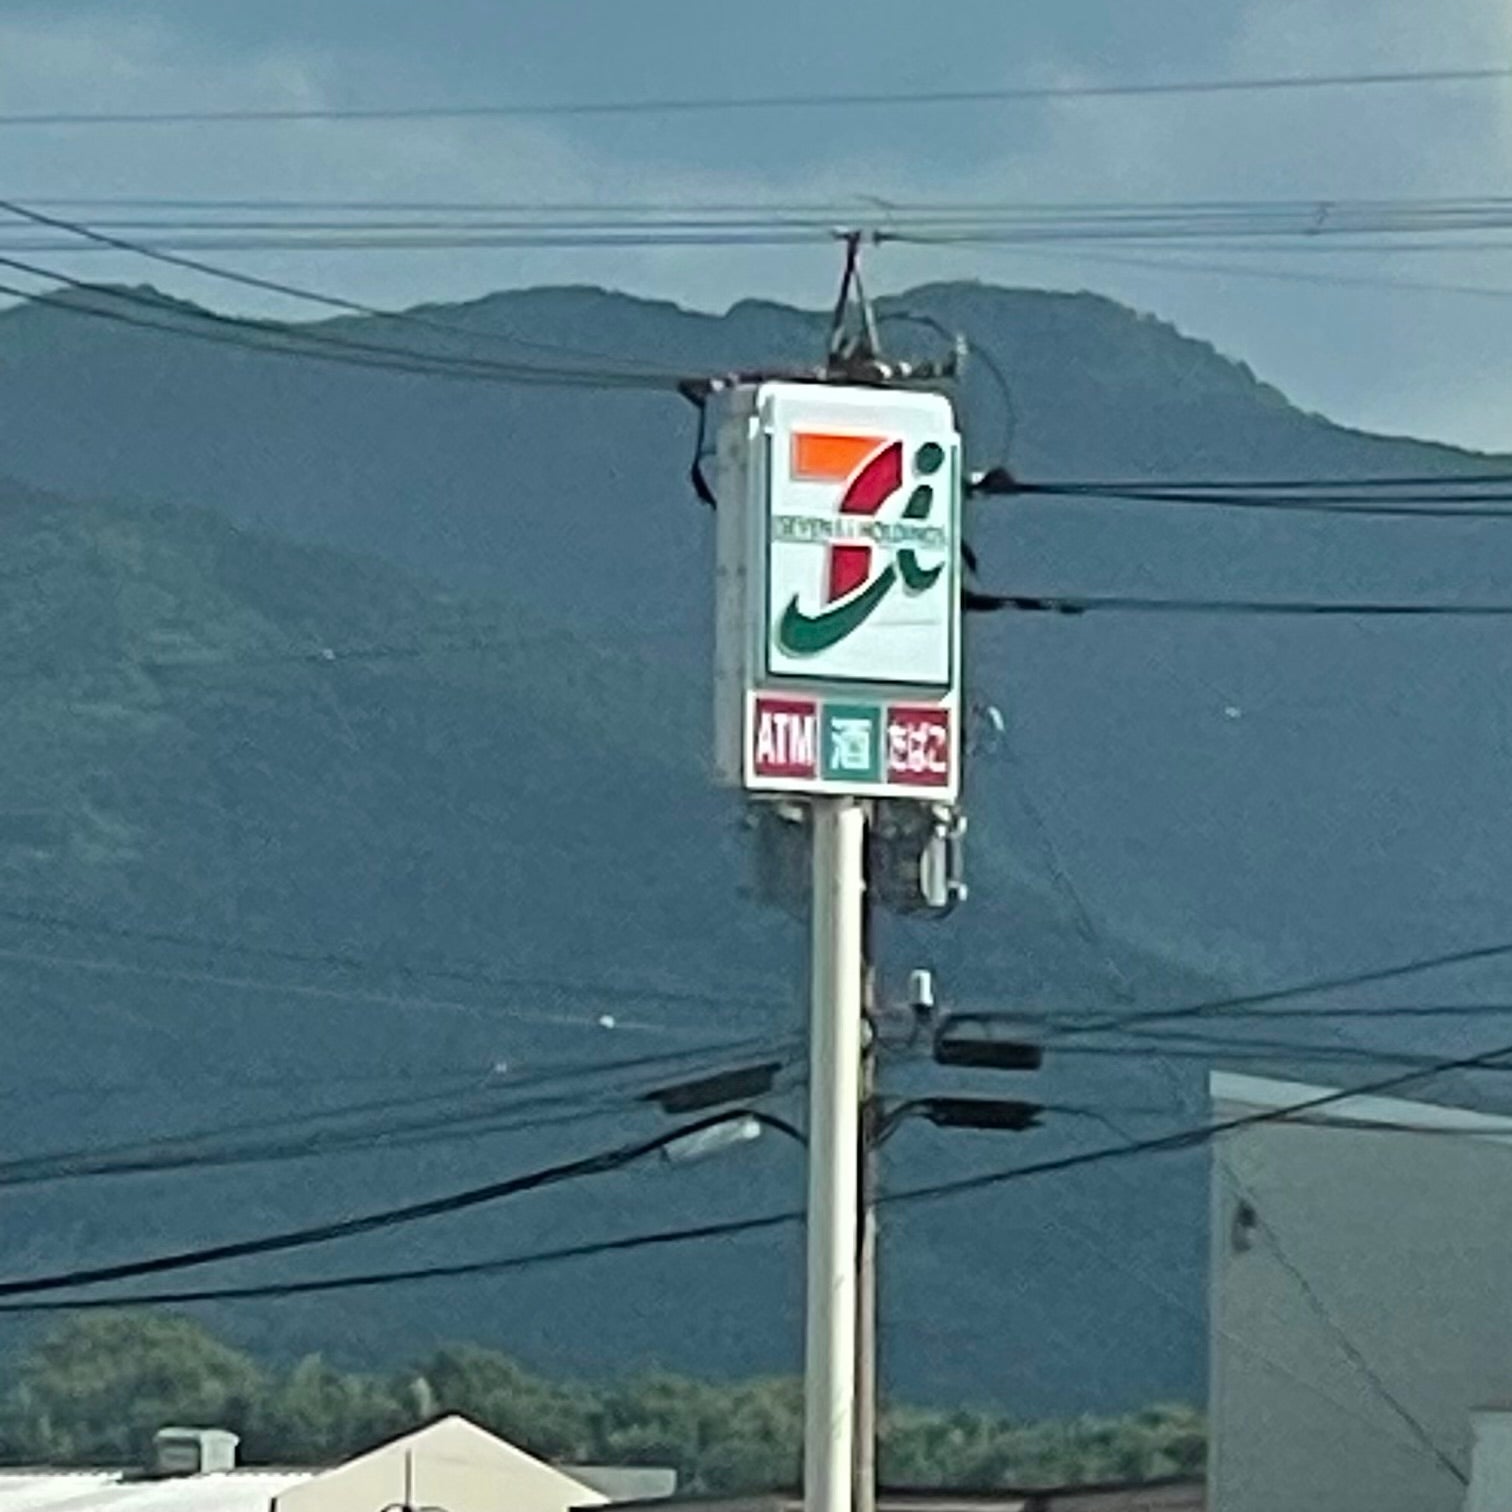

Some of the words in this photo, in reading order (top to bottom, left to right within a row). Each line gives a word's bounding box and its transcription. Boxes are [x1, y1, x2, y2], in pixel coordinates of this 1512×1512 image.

[758, 712, 816, 766] ATM
[831, 717, 872, 770] 酒
[888, 721, 947, 773] たばこ
